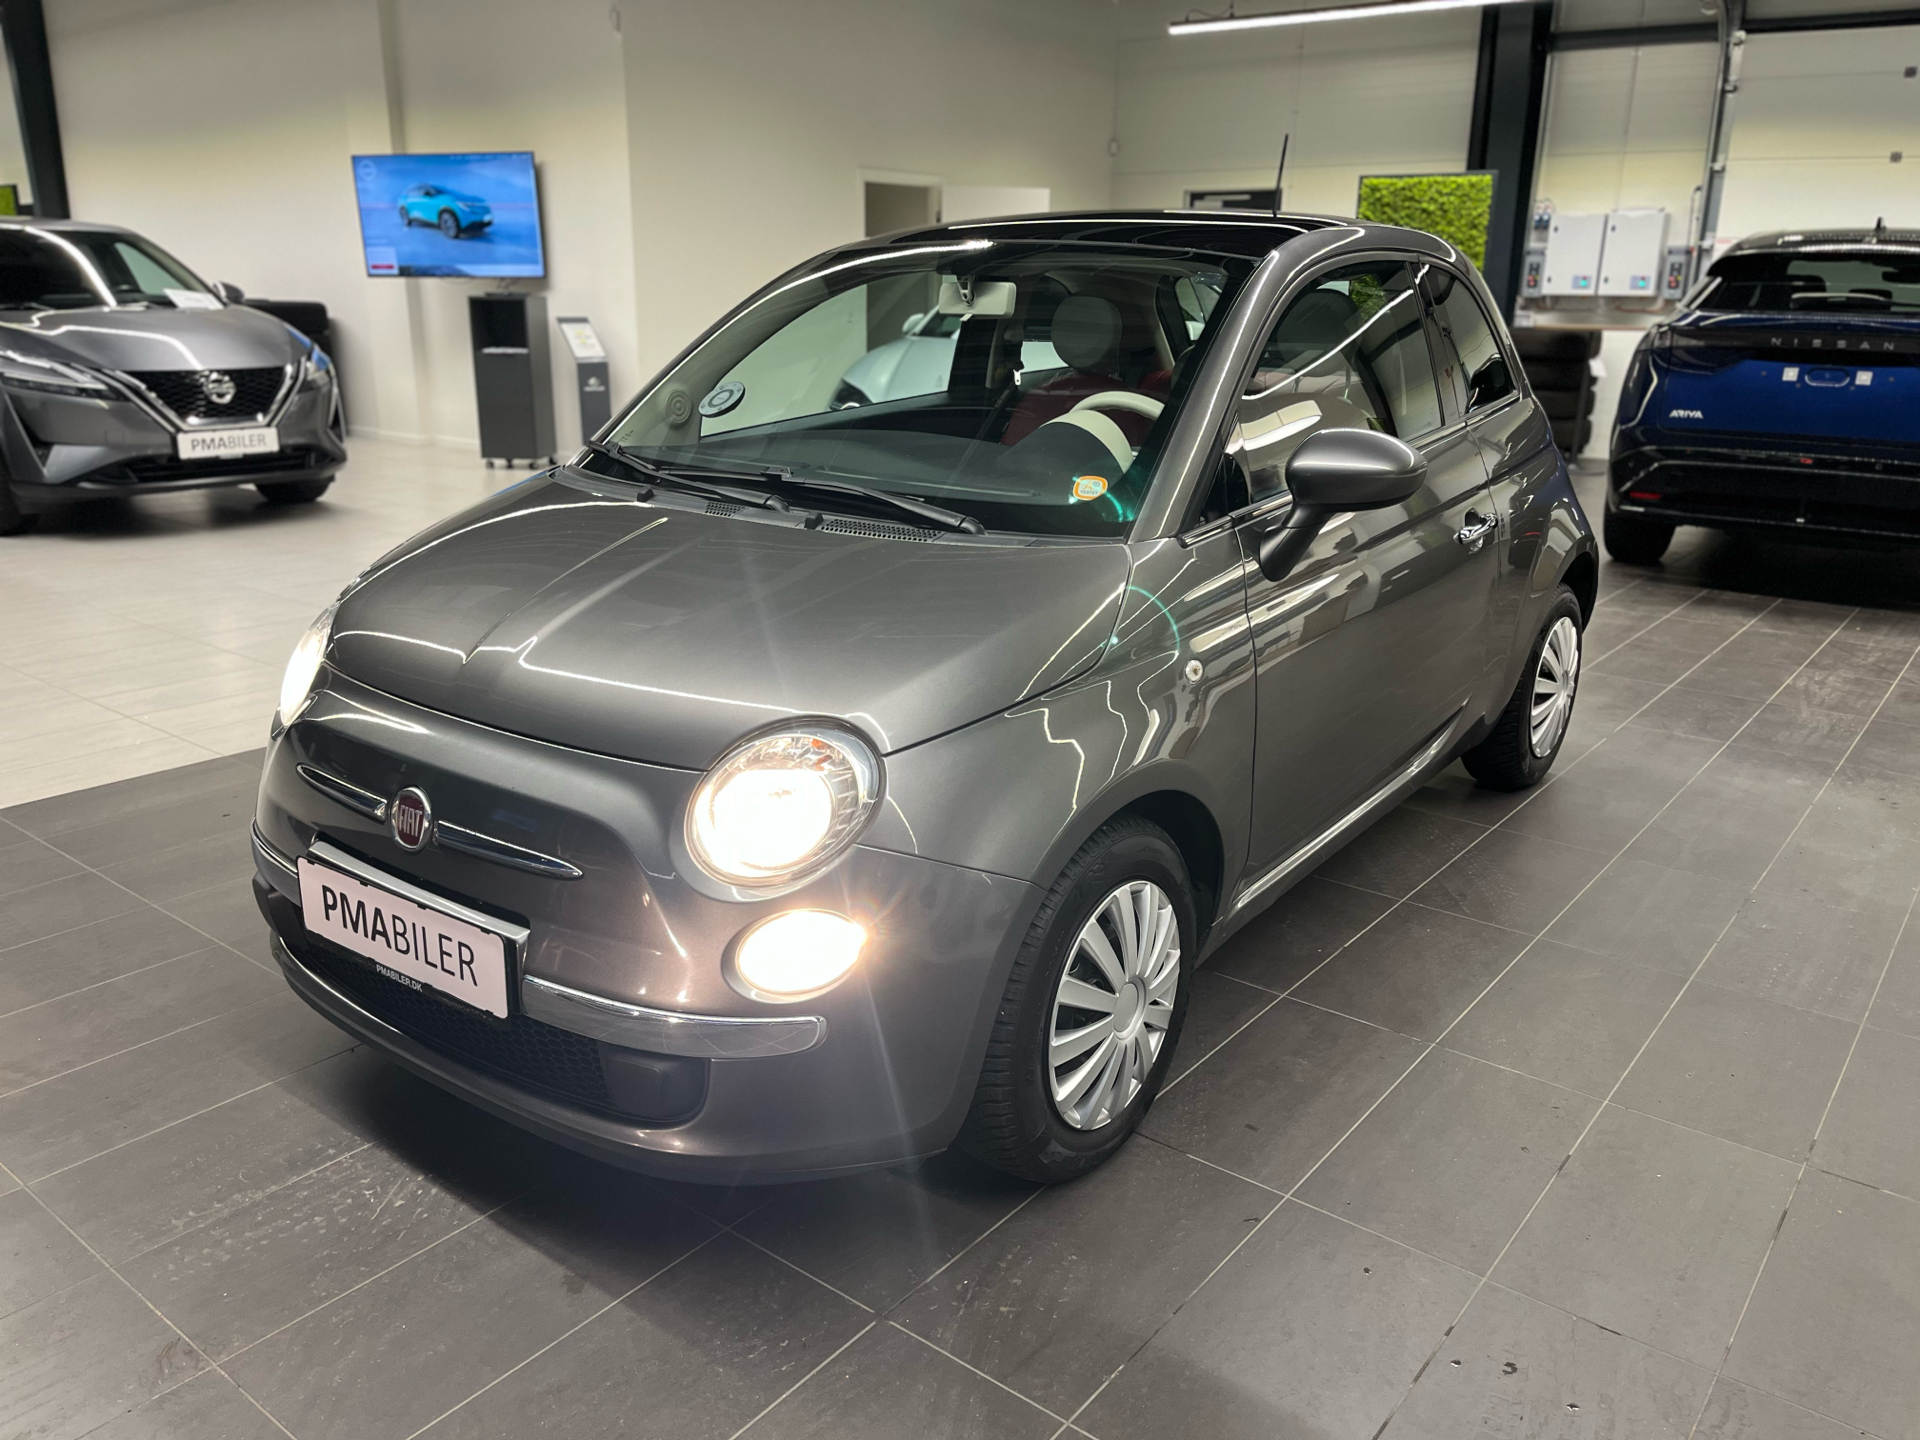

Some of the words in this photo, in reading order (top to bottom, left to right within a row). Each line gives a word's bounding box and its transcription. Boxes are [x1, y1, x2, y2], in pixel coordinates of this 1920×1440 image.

[1771, 337, 1895, 350] NISSAN
[1669, 409, 1704, 419] ARIYA
[191, 433, 267, 452] PMABILER
[399, 804, 423, 837] FIAT
[321, 884, 478, 987] PMABILER
[376, 964, 423, 993] PMABILER.DK
